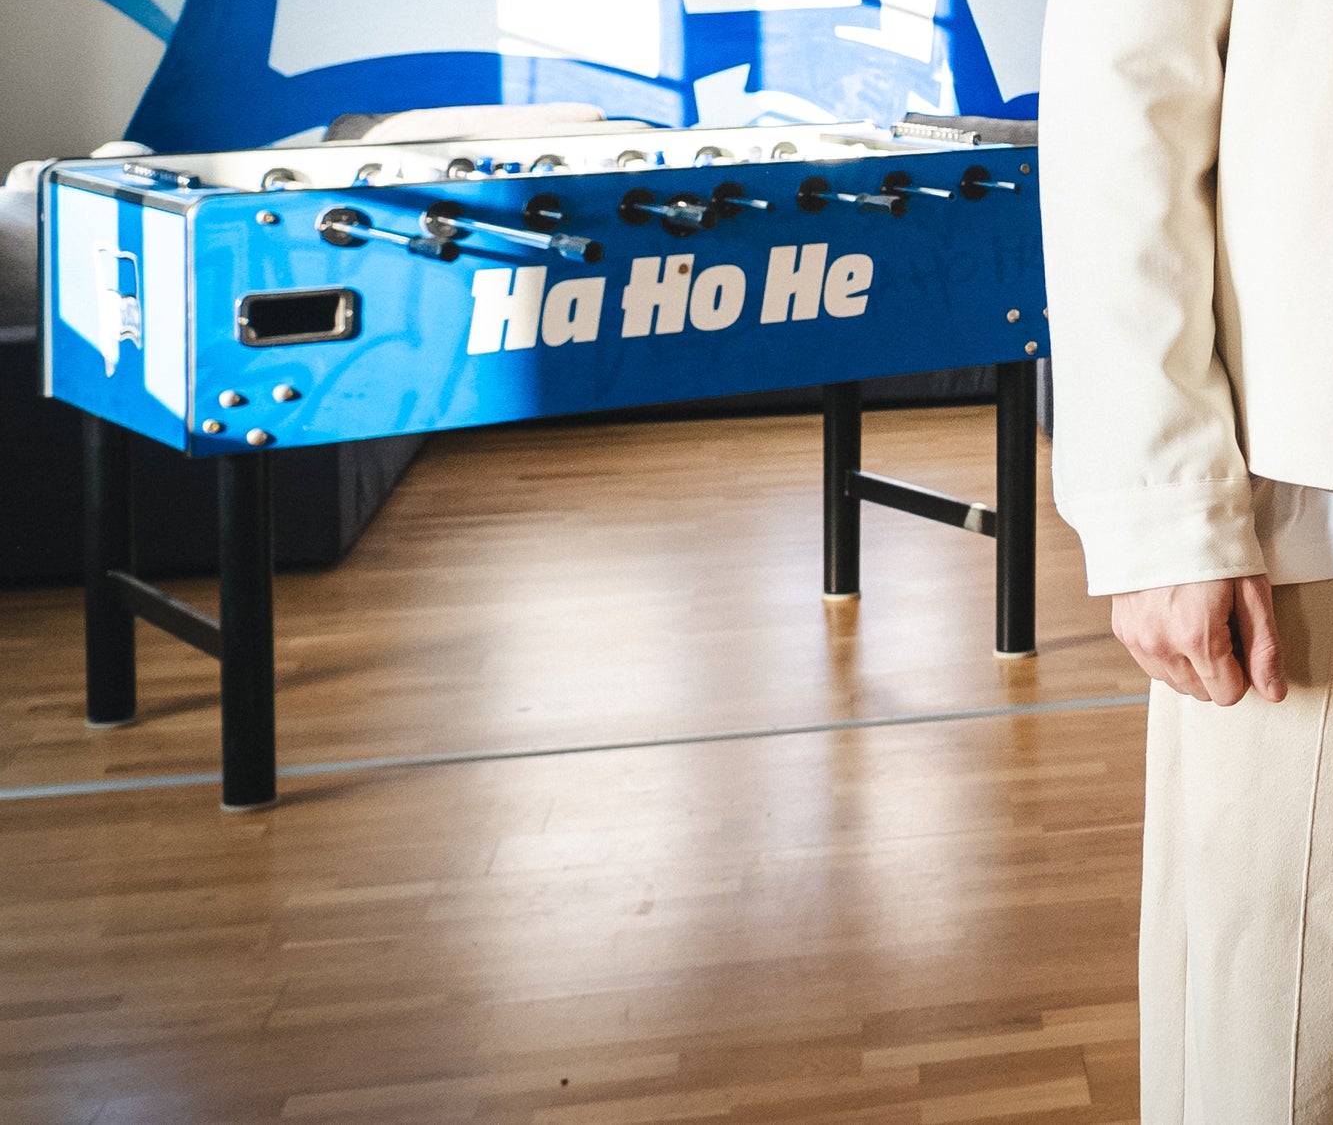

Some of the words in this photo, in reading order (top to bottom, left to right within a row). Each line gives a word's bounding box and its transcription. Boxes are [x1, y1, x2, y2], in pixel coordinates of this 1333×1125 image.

[467, 265, 606, 355] Ha
[621, 253, 746, 338] Ho
[760, 243, 874, 325] He
